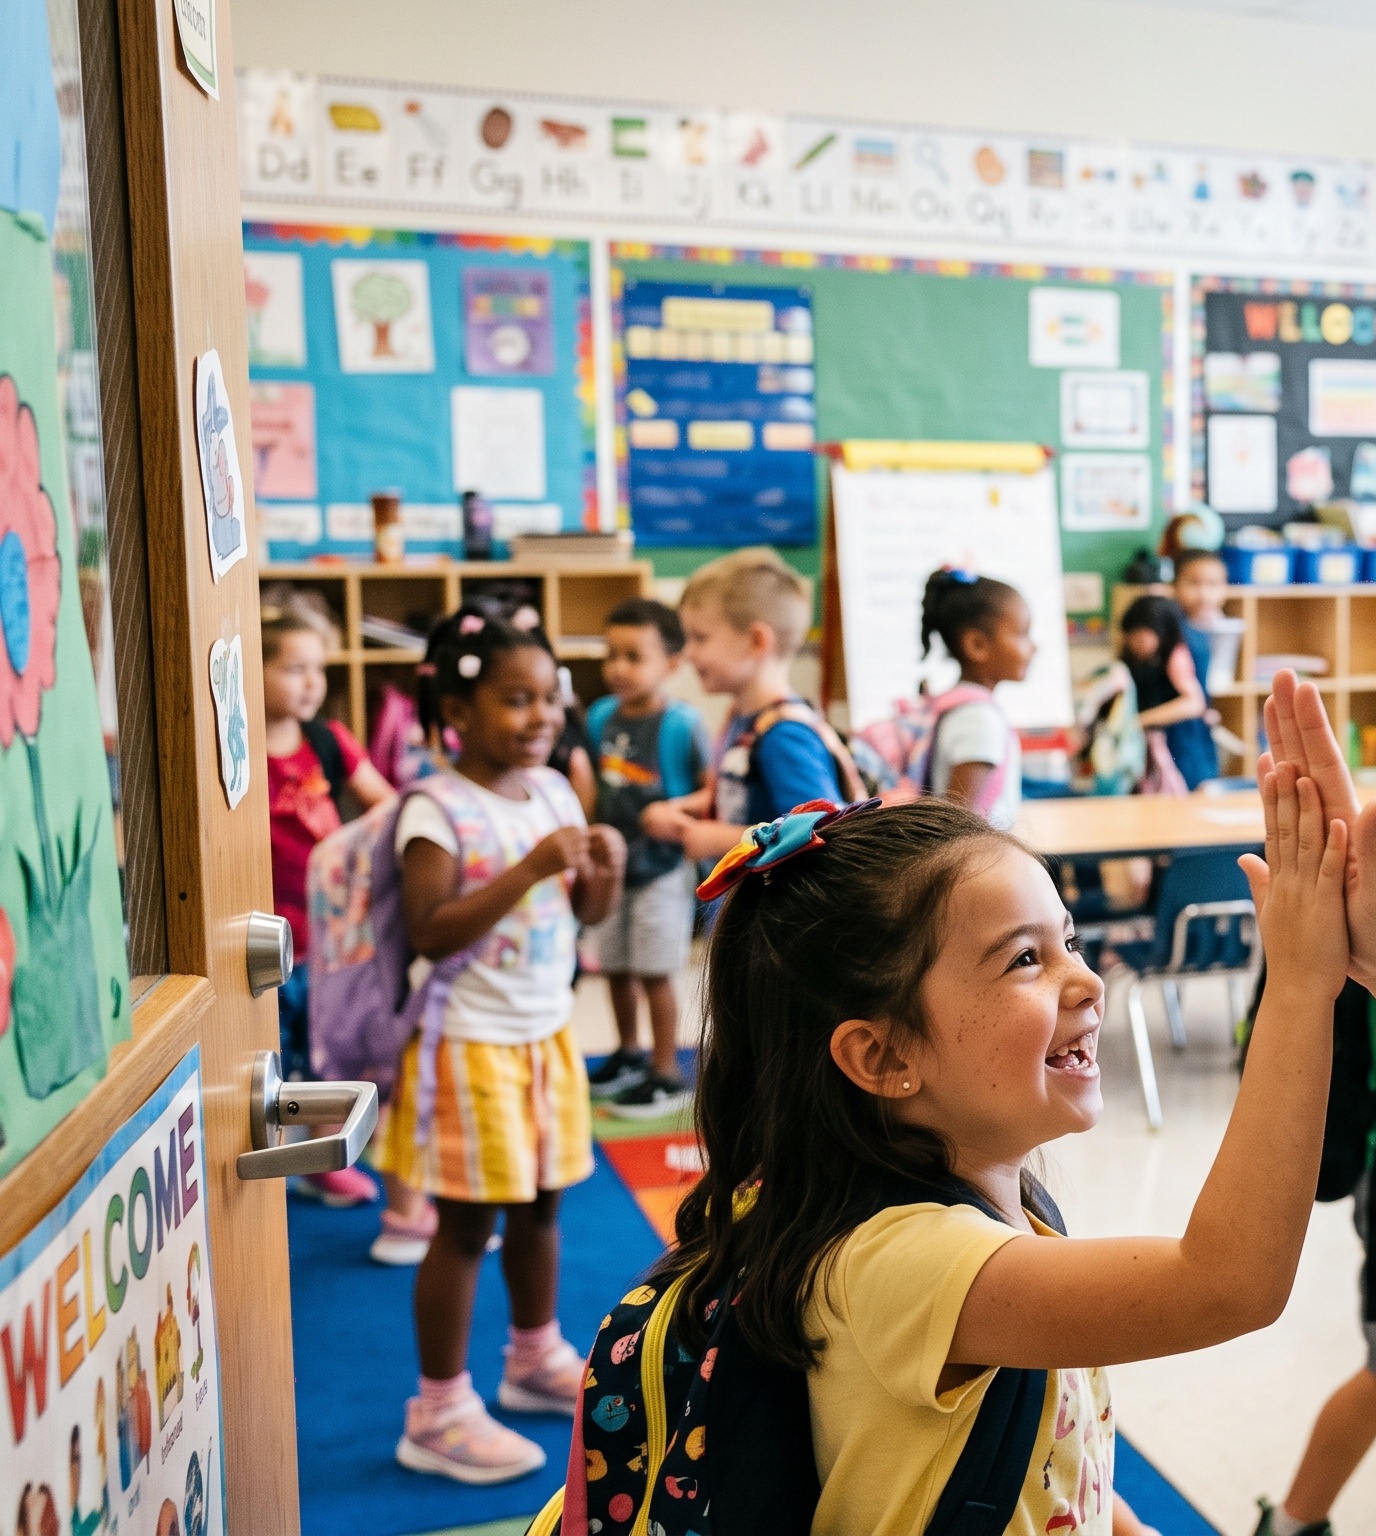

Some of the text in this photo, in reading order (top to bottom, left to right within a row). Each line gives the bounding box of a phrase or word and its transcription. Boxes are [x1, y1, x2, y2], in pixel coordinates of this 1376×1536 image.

[257, 144, 310, 185] Dd
[334, 150, 378, 188] Ee
[407, 153, 447, 191] Ff
[469, 157, 524, 212] Gg
[1, 1101, 199, 1447] WELCOME
